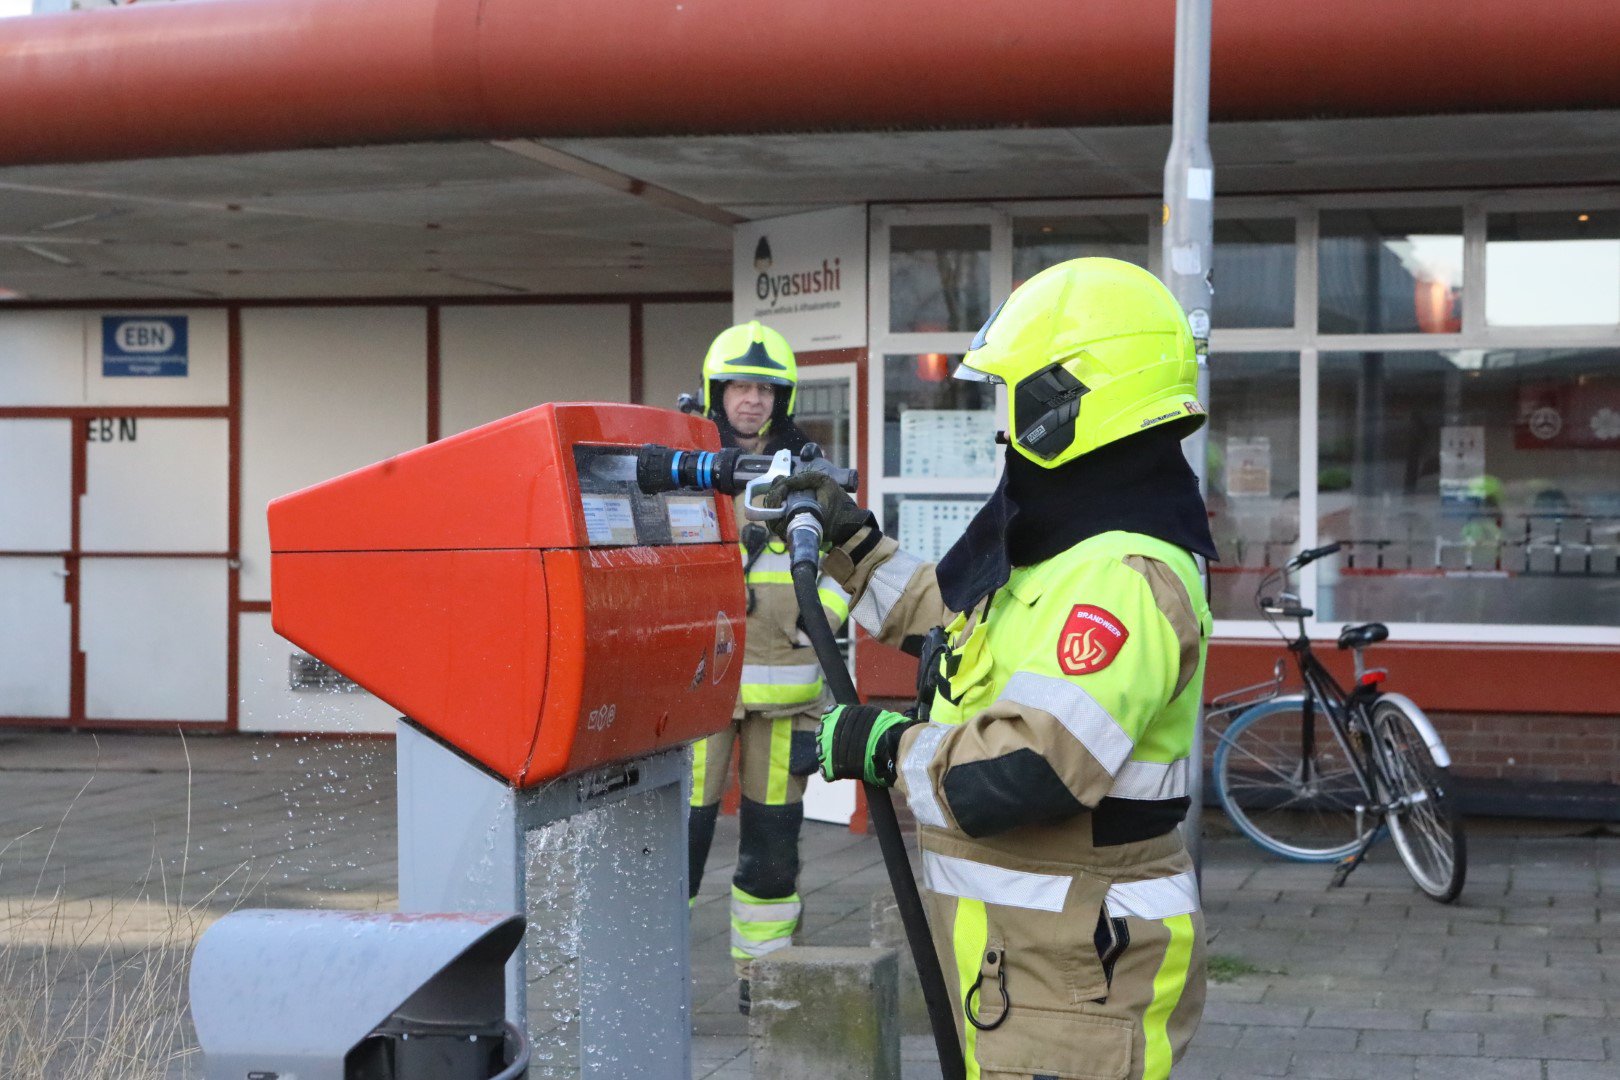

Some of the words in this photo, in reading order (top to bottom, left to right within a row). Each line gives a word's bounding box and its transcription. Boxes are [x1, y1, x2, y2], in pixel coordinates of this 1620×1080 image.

[756, 258, 841, 306] Oyasushi
[125, 326, 165, 346] EBN
[86, 416, 136, 442] EBN
[1077, 611, 1122, 638] BRANDWEER
